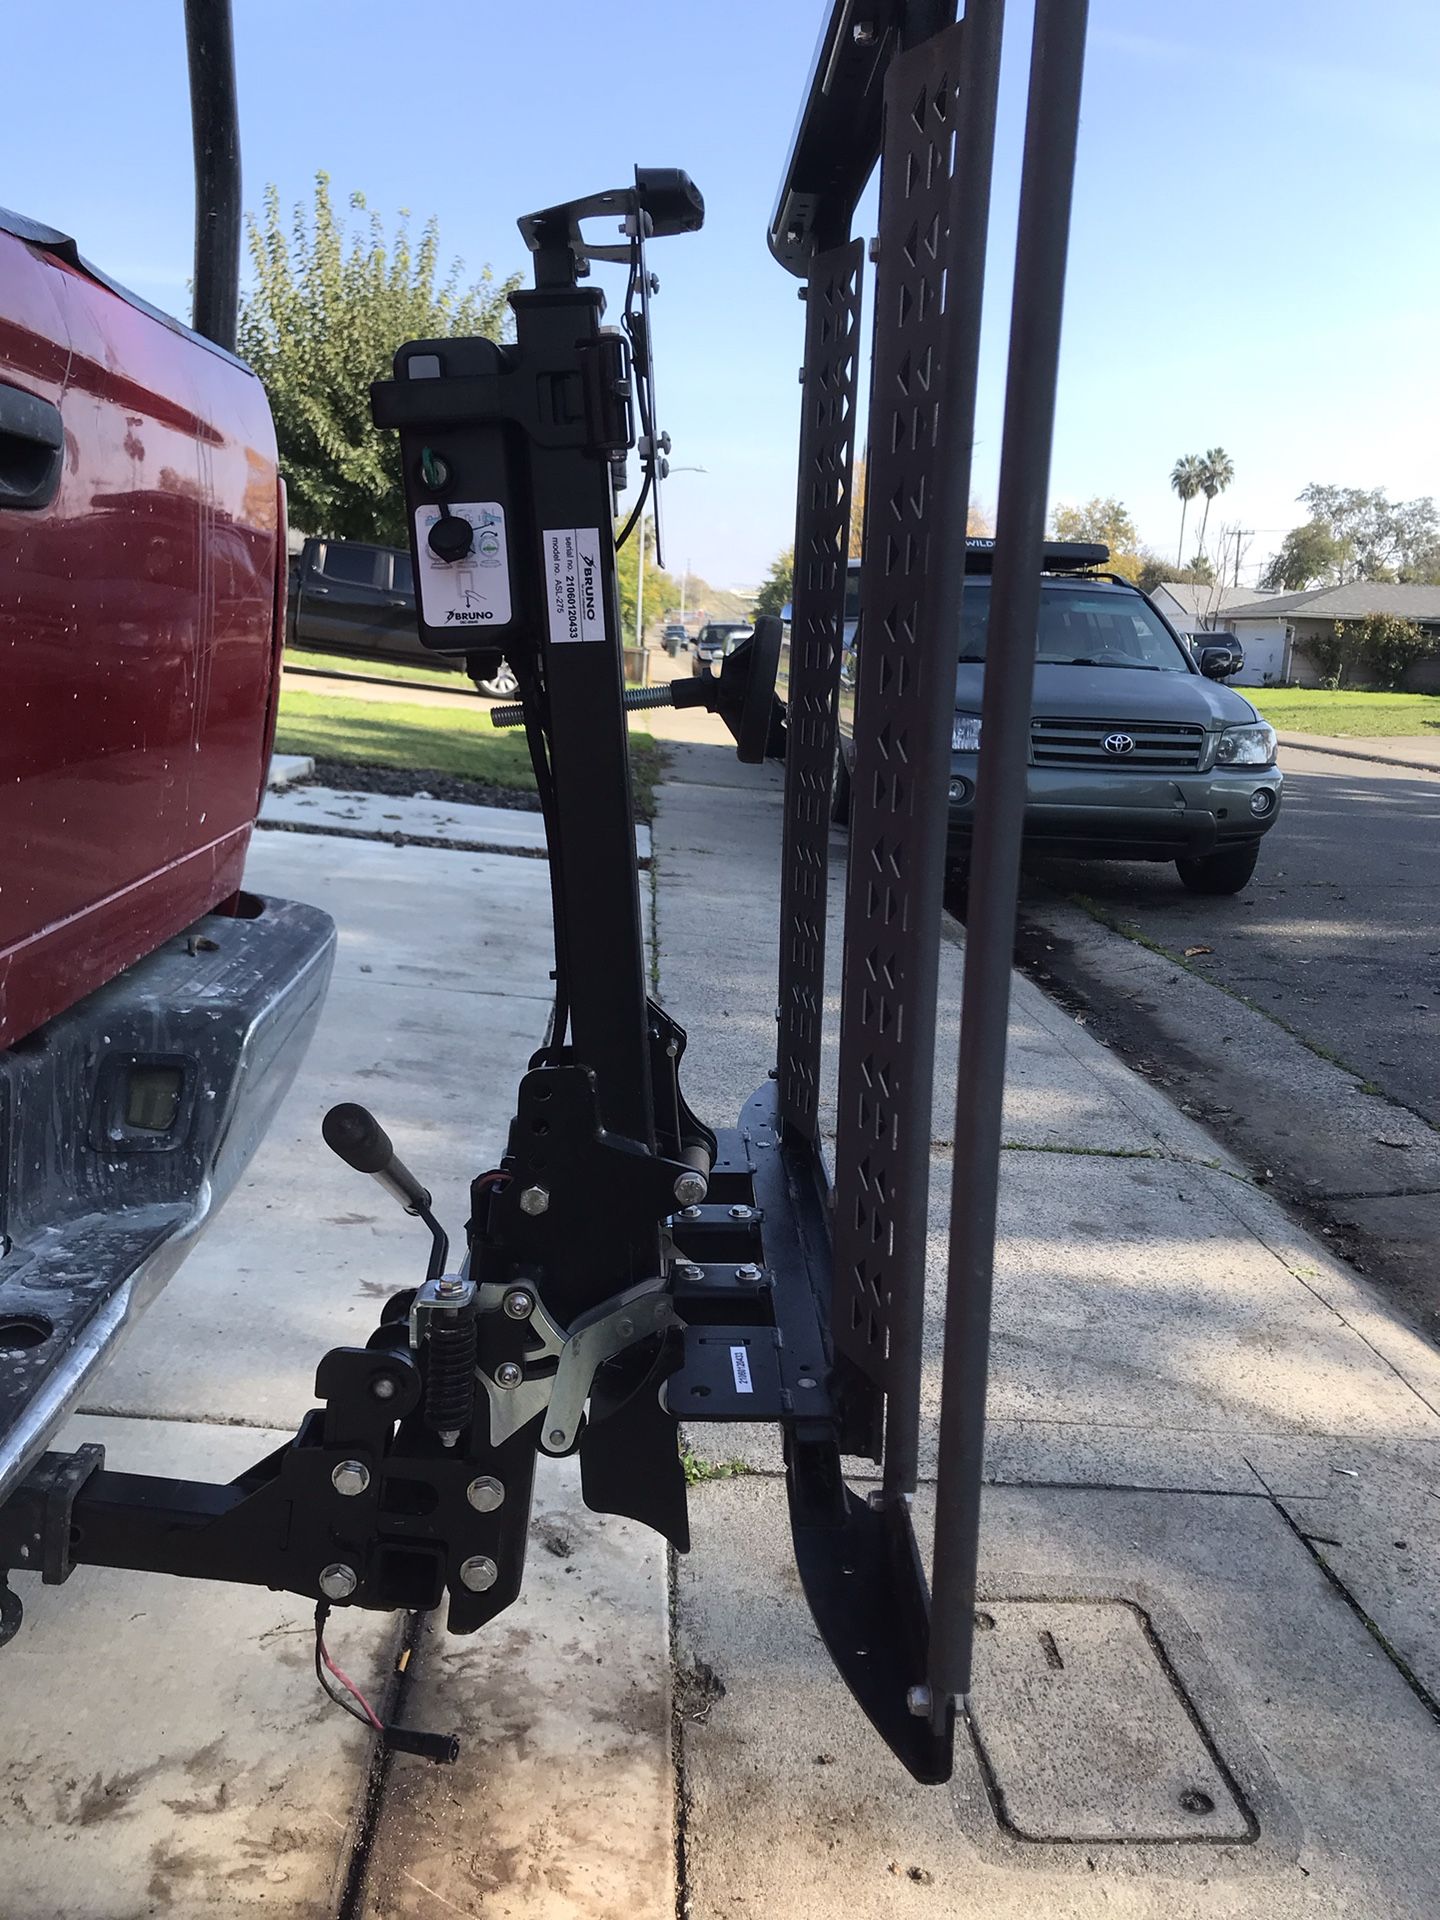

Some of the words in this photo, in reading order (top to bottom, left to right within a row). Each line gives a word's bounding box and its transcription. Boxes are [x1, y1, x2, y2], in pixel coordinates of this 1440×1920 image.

[552, 537, 560, 562] model
[565, 537, 574, 558] serial
[965, 539, 996, 547] WILD
[555, 579, 564, 614] ASL-275
[584, 567, 595, 620] BRUNO
[455, 611, 493, 620] BRUNO
[566, 575, 578, 639] 21060120433
